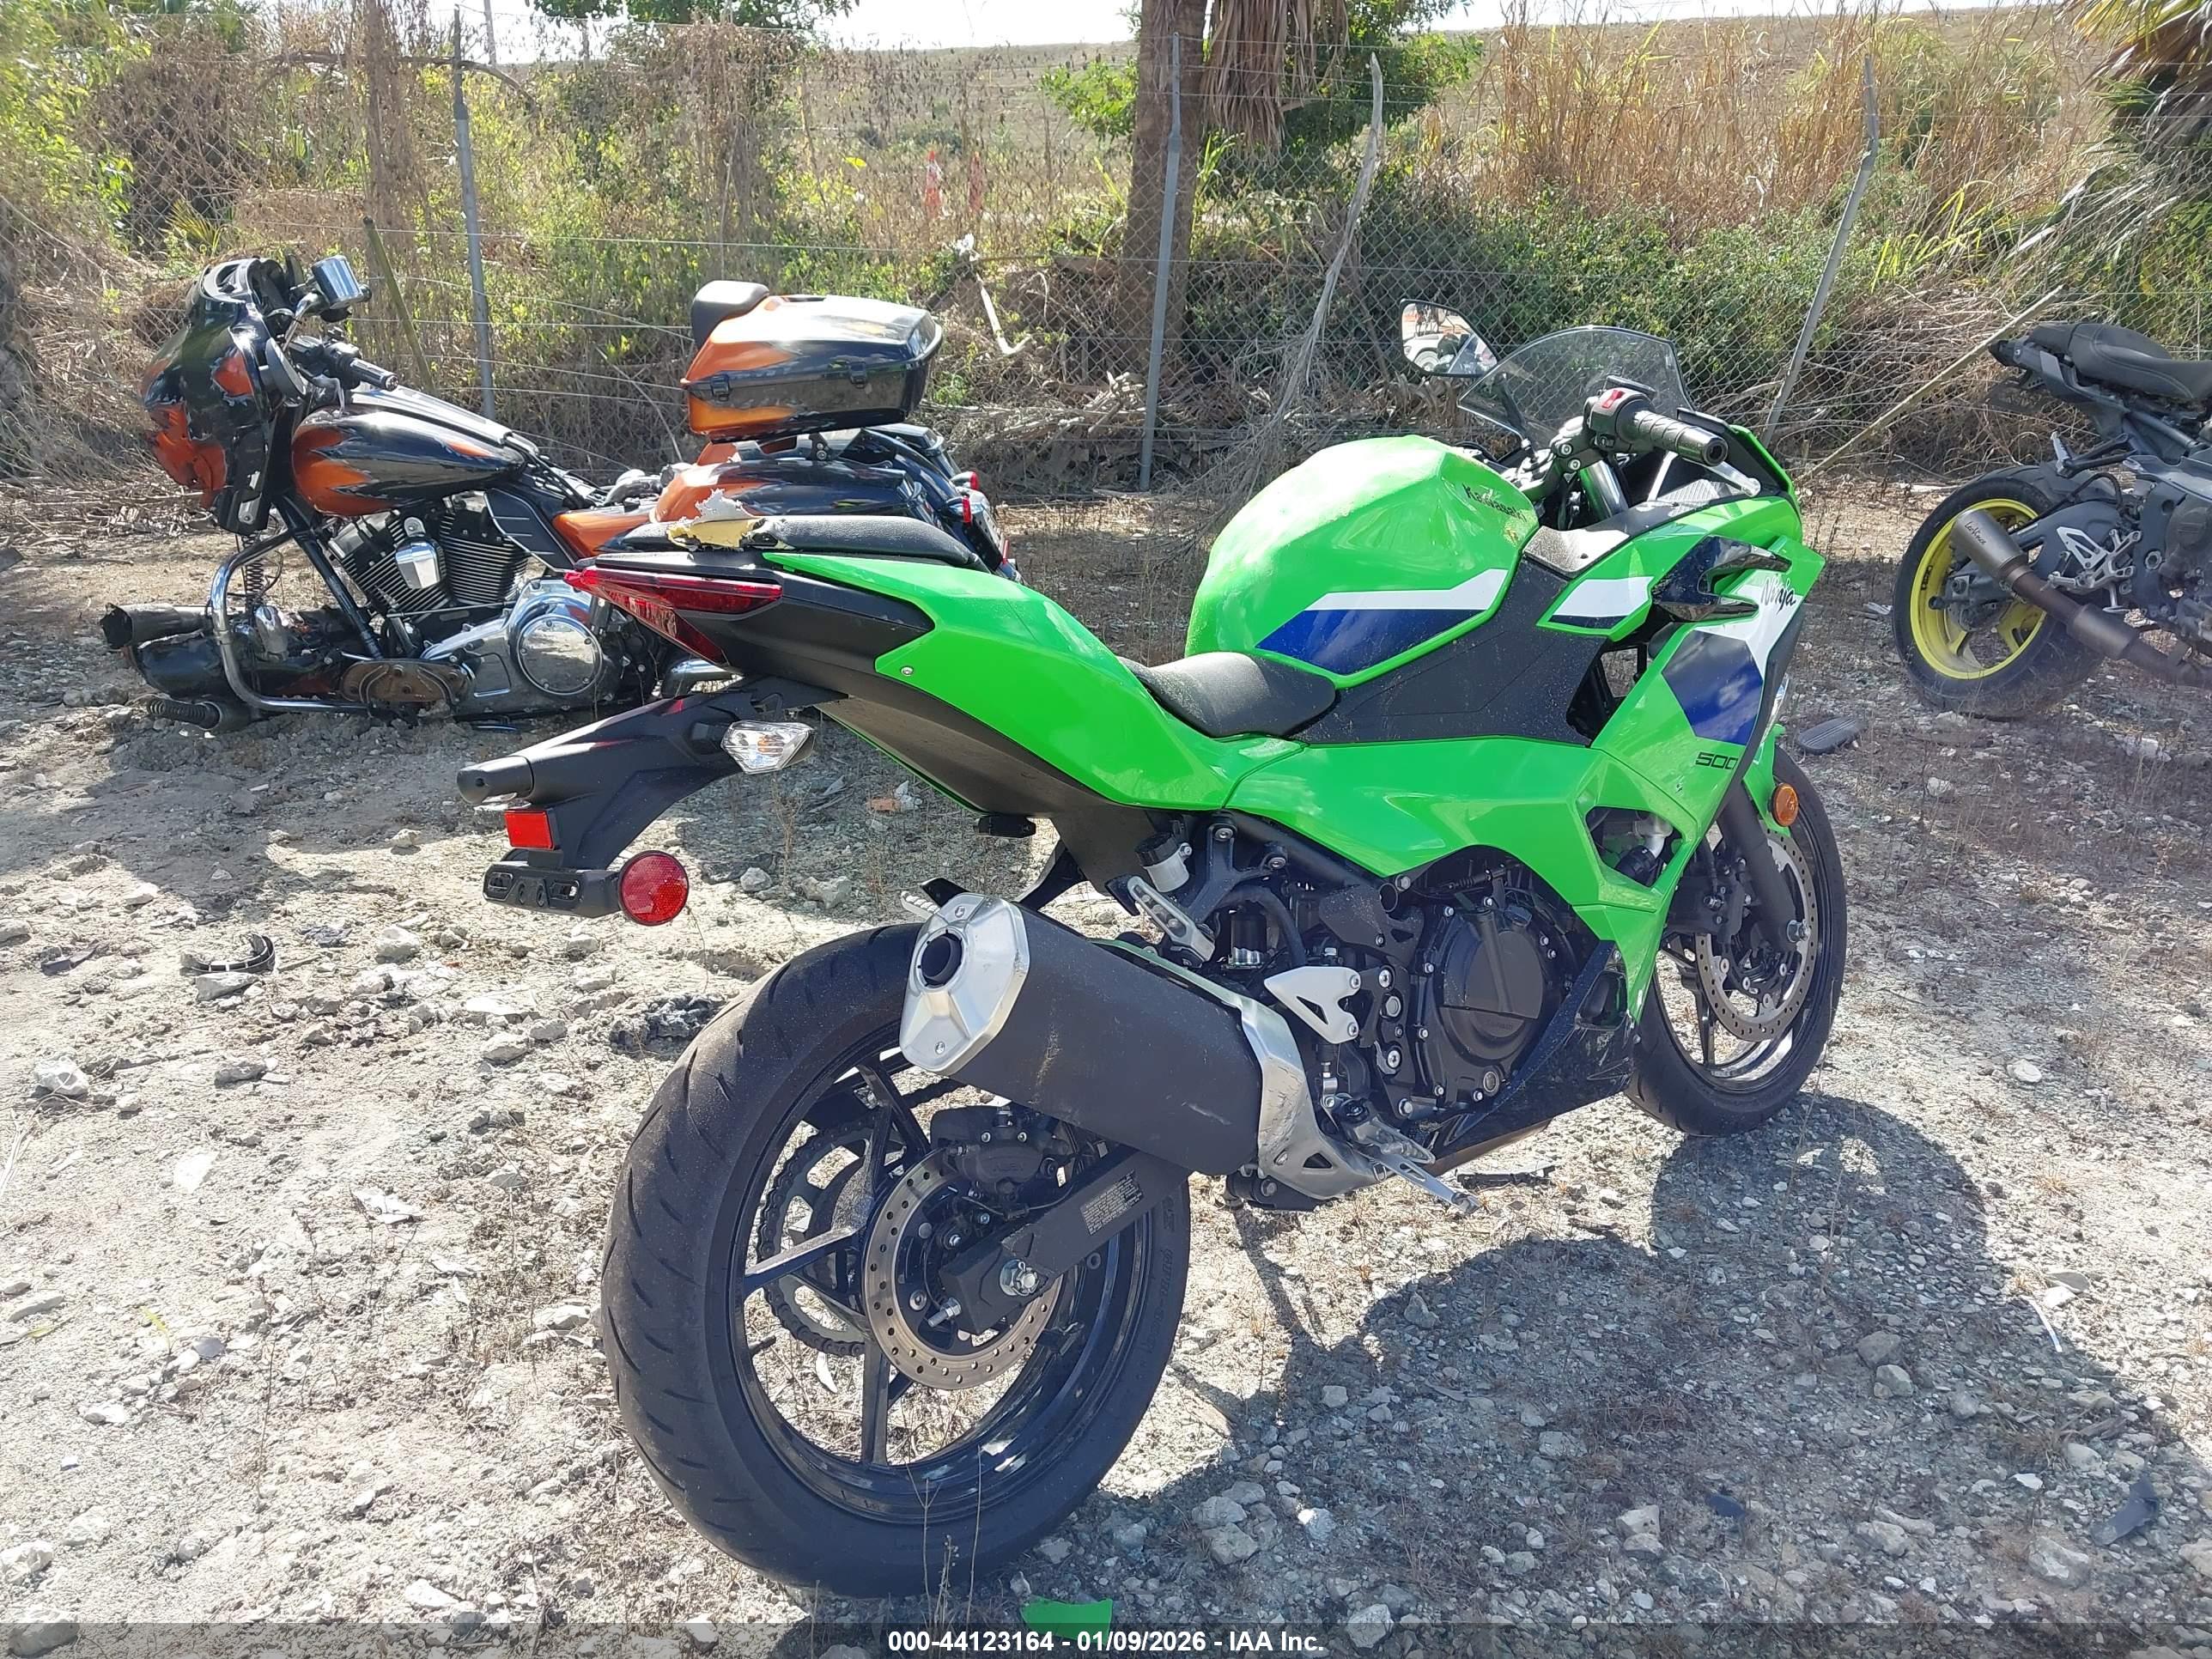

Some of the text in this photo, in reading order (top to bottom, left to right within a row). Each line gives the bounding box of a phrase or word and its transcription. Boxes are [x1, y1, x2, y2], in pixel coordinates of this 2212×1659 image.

[1462, 482, 1528, 522] Kawasaki
[1760, 576, 1797, 616] Ninja
[1695, 751, 1739, 770] 500
